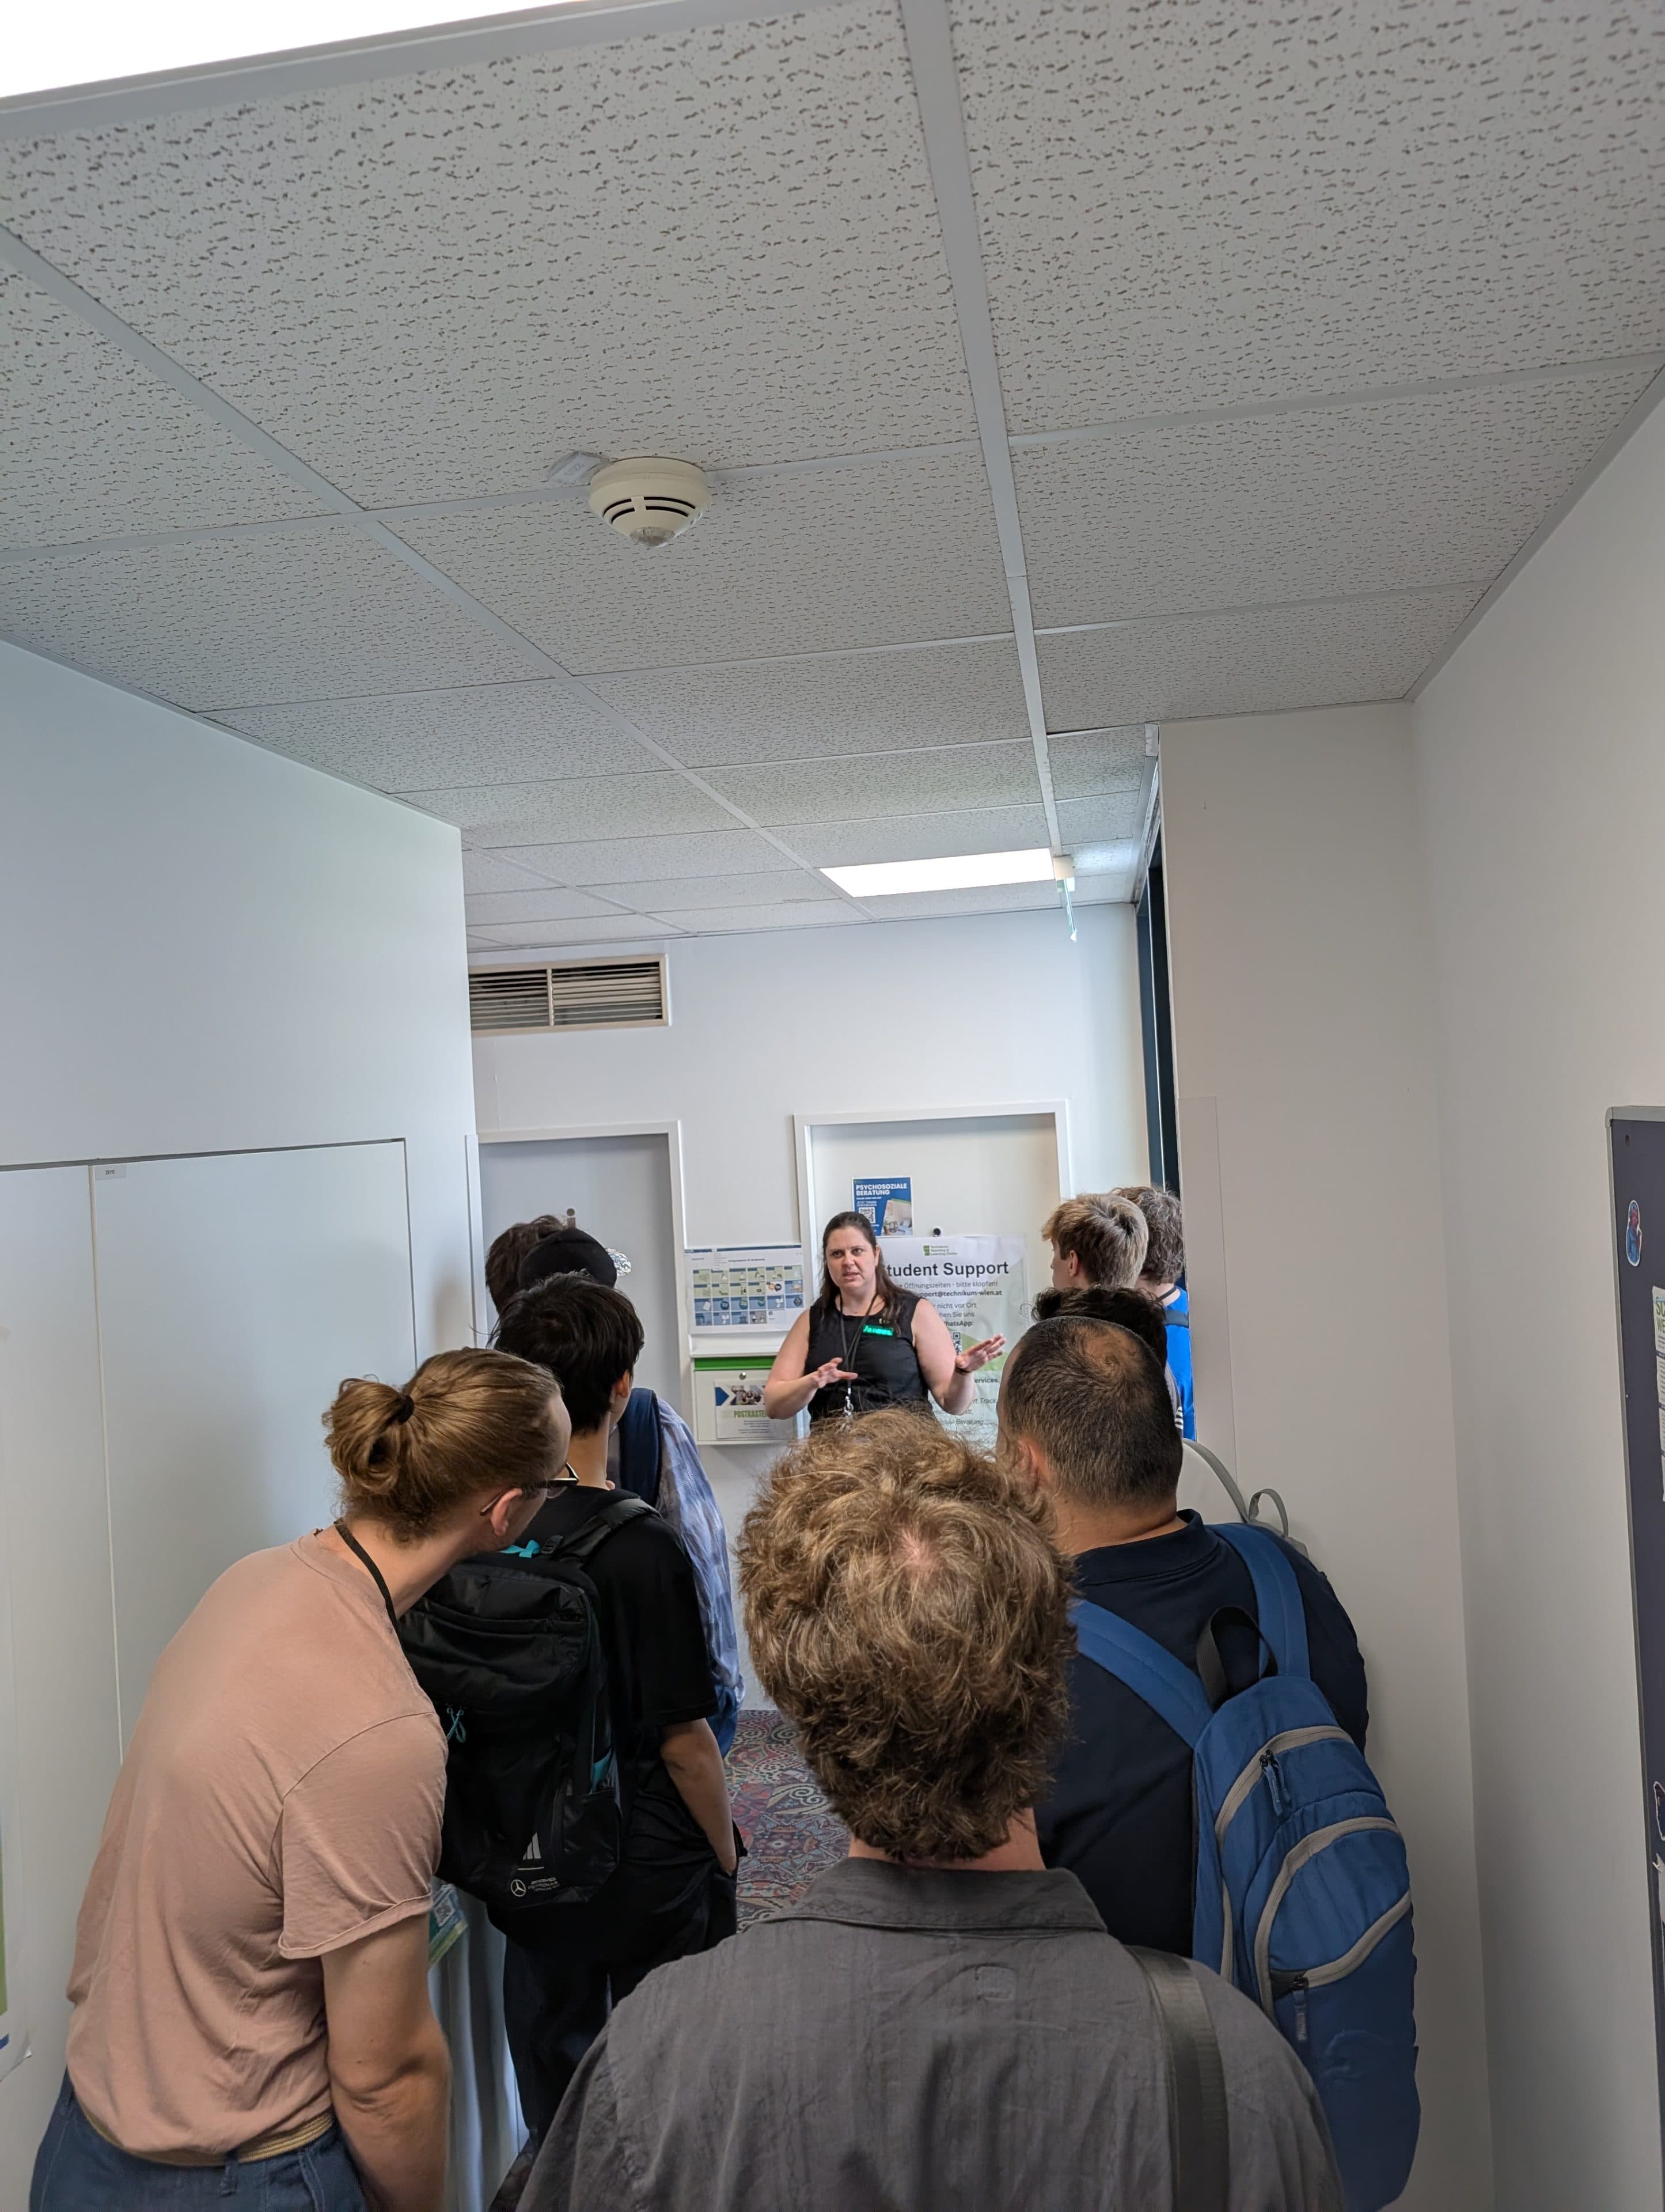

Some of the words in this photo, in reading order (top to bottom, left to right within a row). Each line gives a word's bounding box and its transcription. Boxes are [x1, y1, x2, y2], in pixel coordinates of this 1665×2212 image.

[887, 1263, 938, 1277] tudent
[943, 1262, 1009, 1278] Support
[904, 1282, 951, 1290] Öffnungszeiten
[972, 1281, 998, 1289] klopfen!
